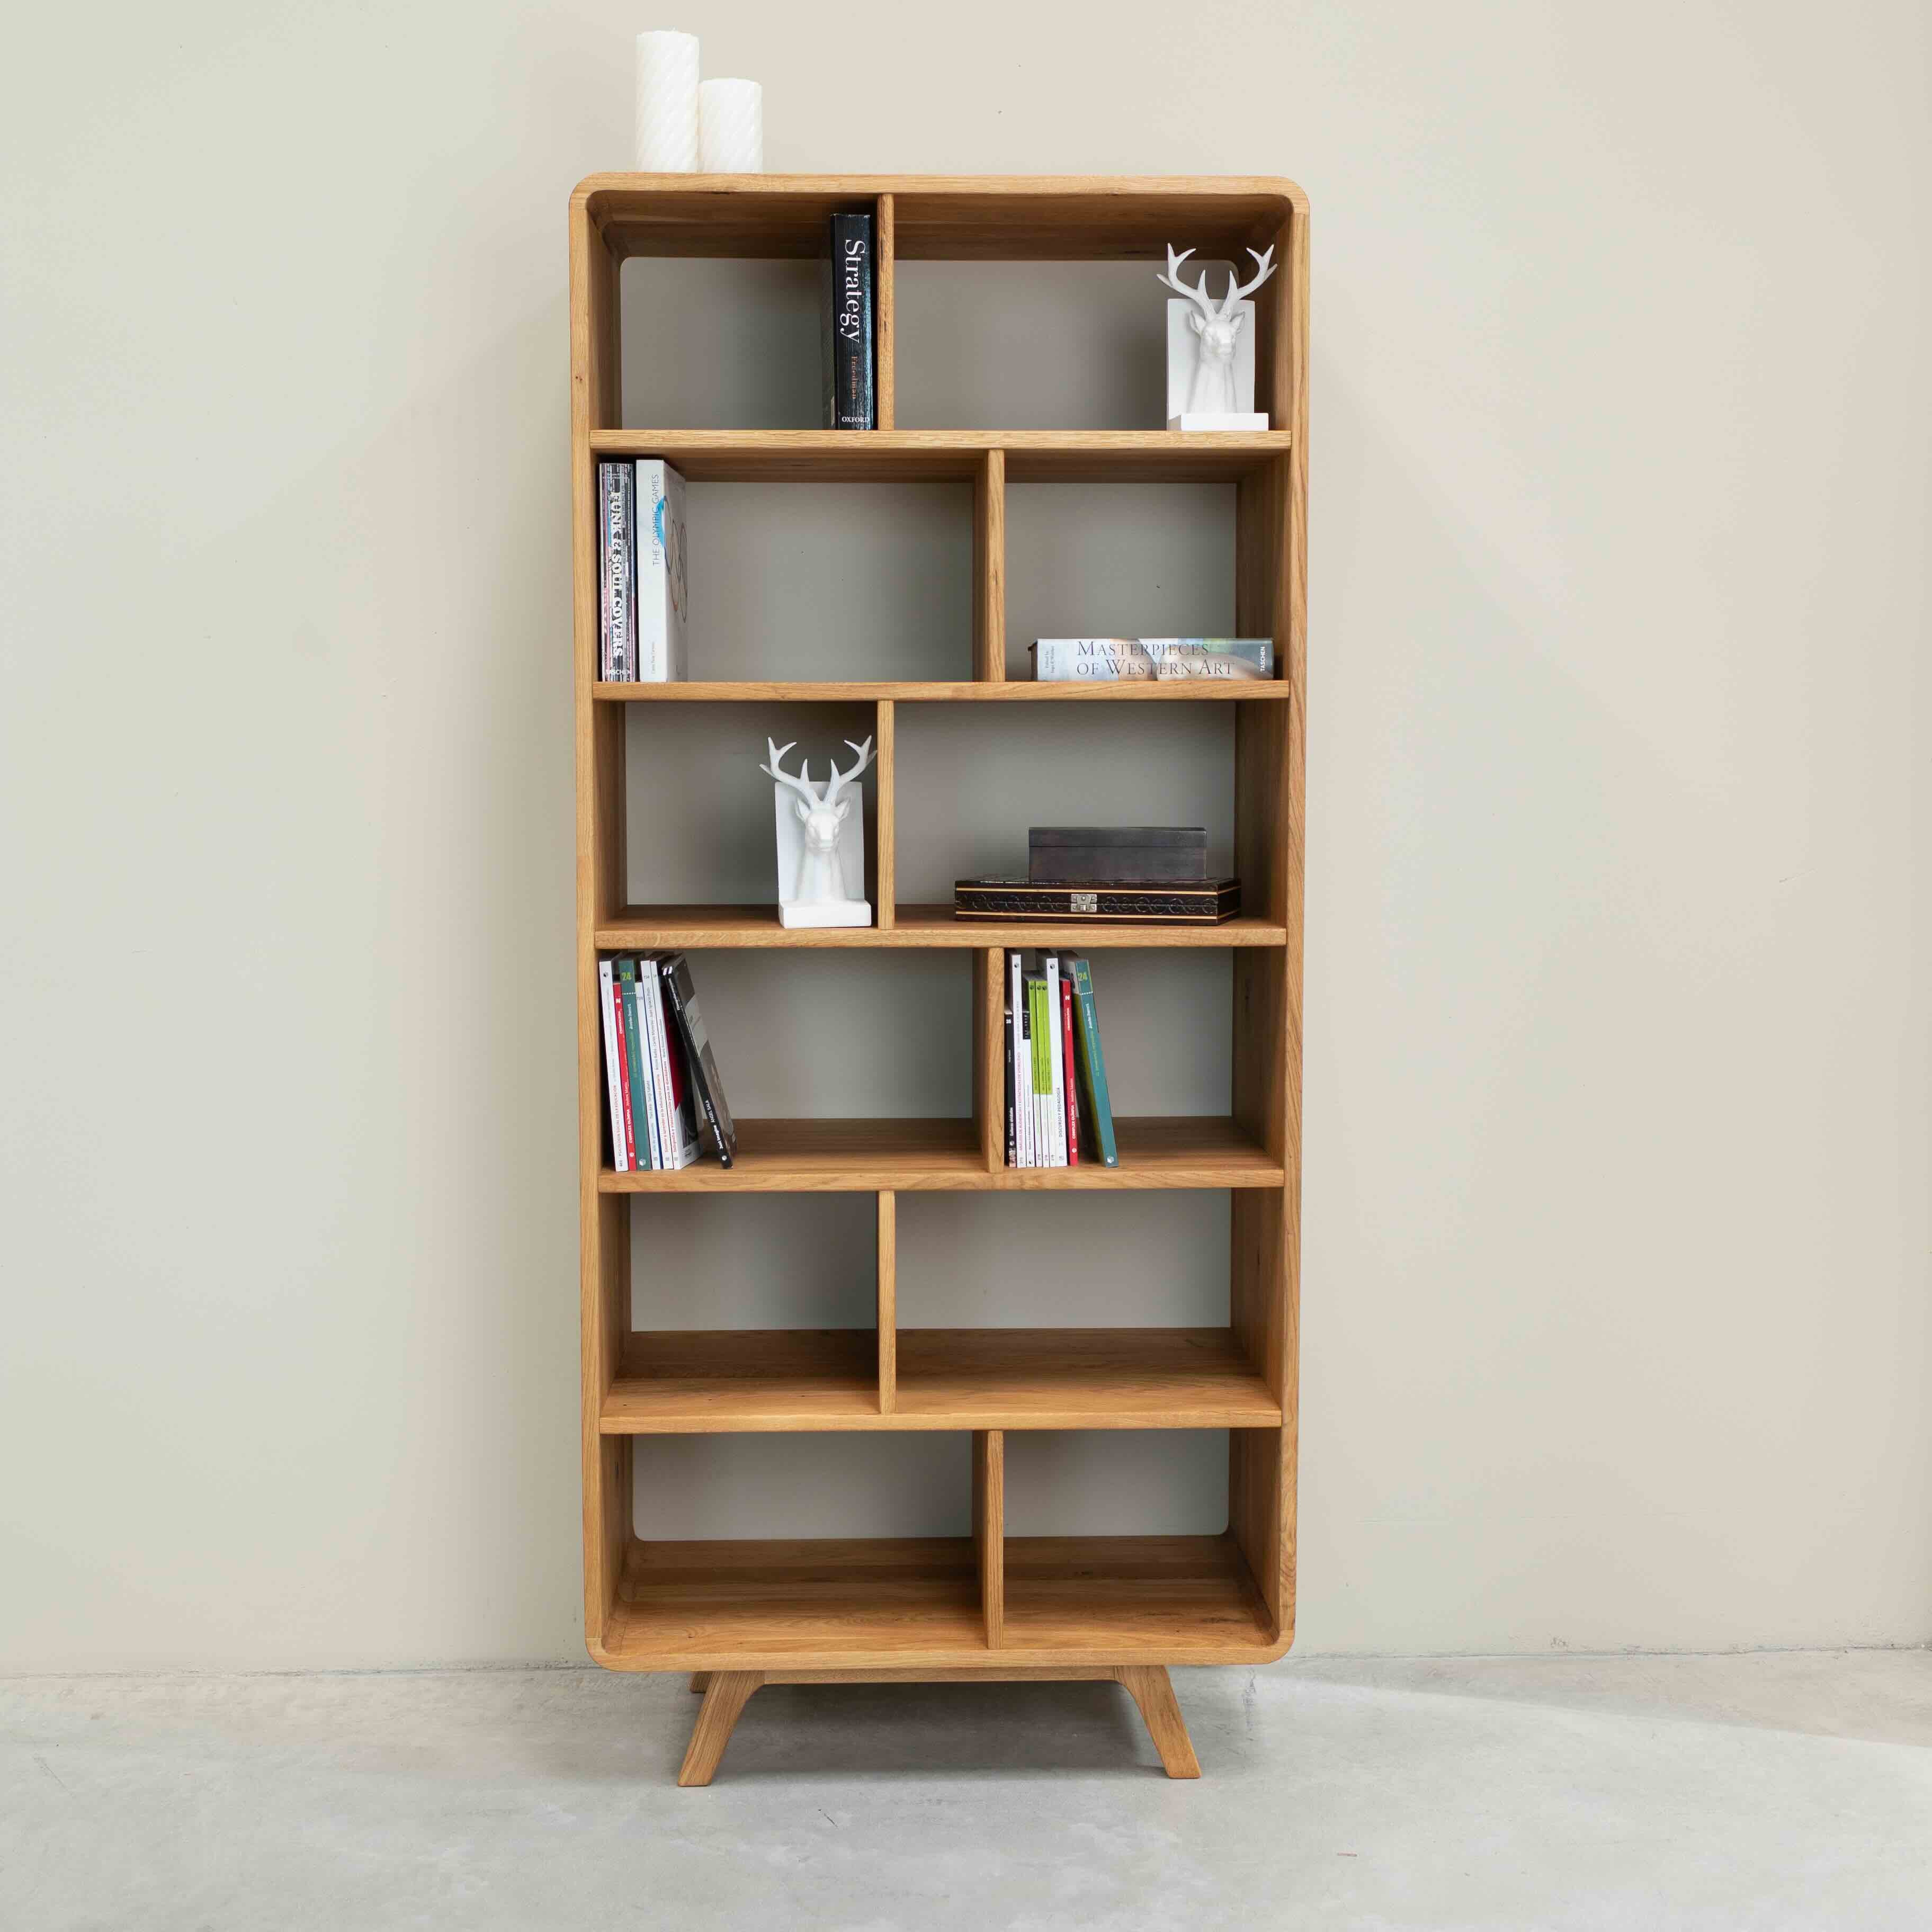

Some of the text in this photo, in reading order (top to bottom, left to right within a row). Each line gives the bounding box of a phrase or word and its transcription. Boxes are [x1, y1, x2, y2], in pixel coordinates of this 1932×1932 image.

[840, 239, 866, 343] Strategy
[651, 474, 660, 504] GAMES
[612, 553, 623, 591] SOUL
[613, 596, 624, 658] COVERS
[1077, 641, 1209, 656] MASTERPIECES
[1077, 659, 1236, 675] OF WESTERN ART
